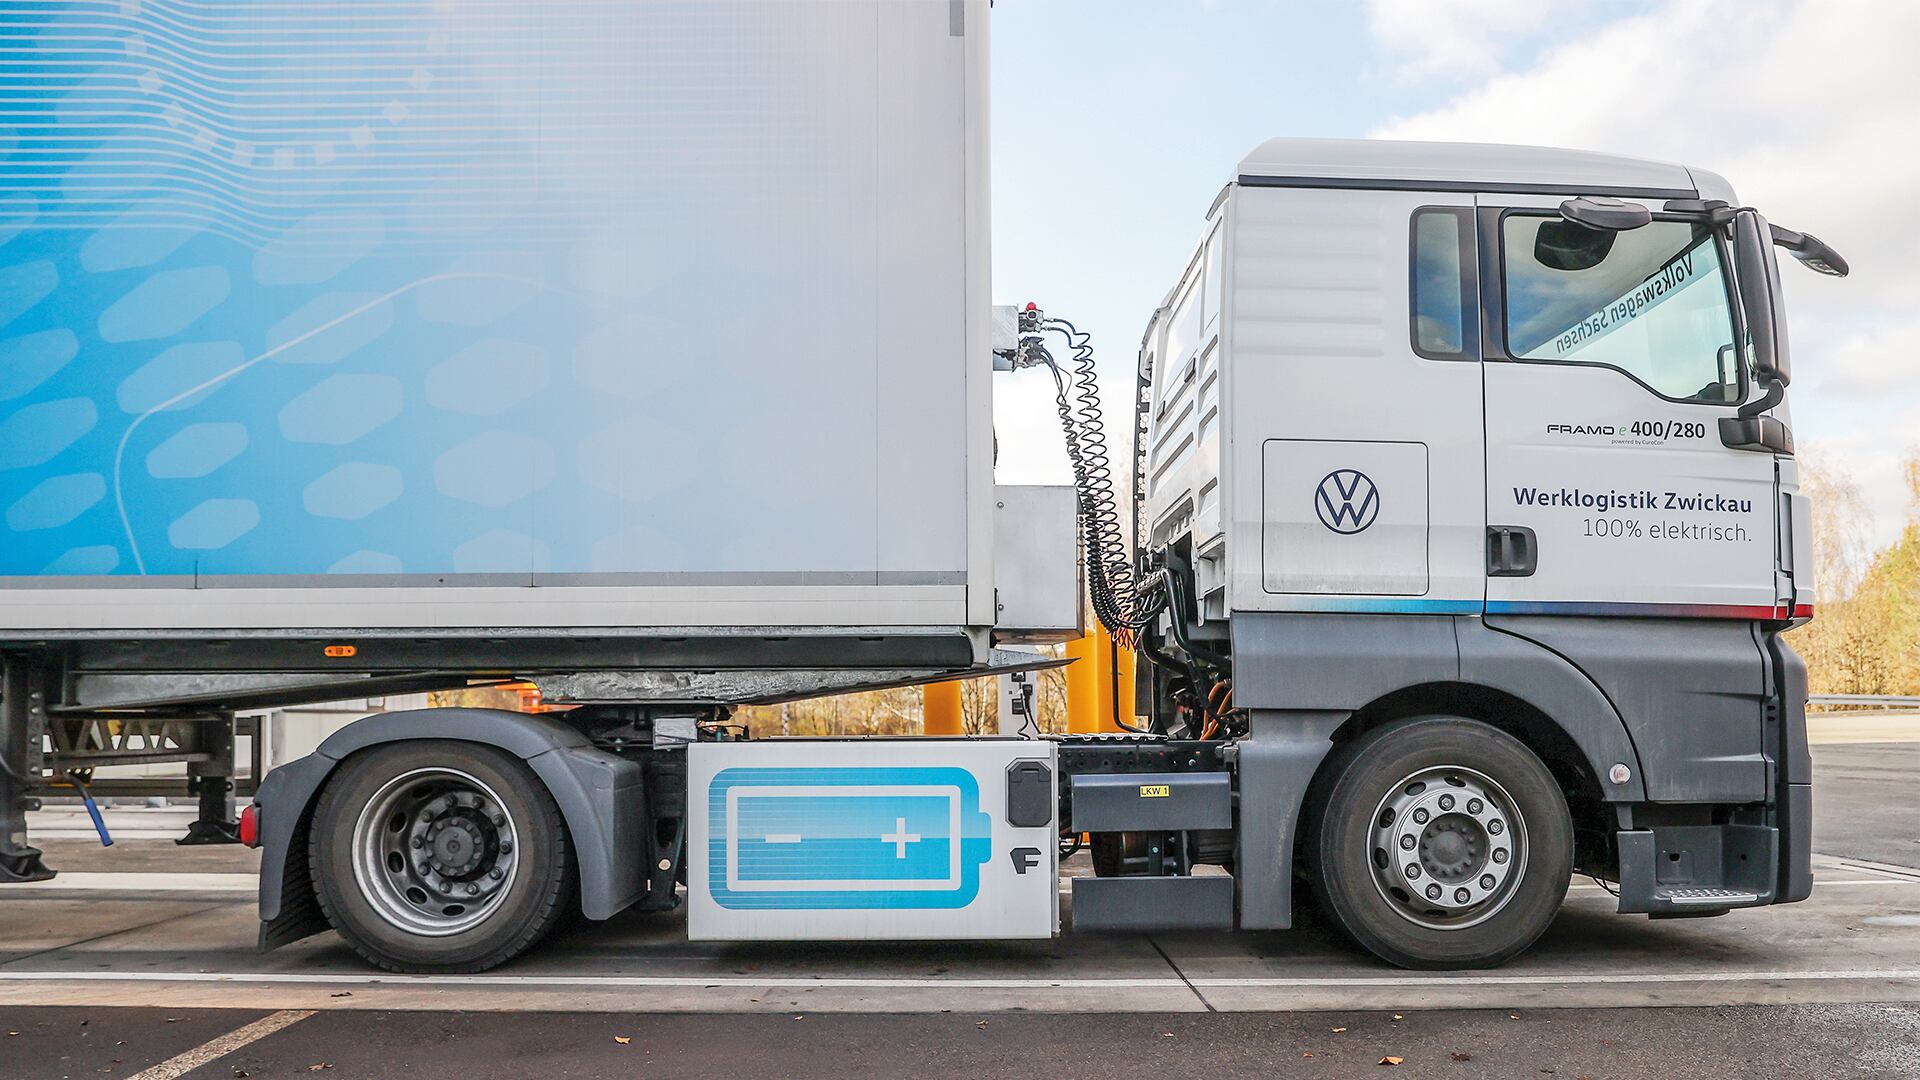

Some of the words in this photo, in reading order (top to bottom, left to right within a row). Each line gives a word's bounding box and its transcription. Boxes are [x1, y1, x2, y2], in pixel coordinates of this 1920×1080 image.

[1631, 420, 1706, 440] 400/280
[1513, 487, 1658, 512] Werklogistik
[1664, 492, 1752, 513] Zwickau
[1583, 518, 1642, 538] 100%
[1649, 520, 1752, 542] elektrisch.
[1141, 787, 1161, 795] LKW
